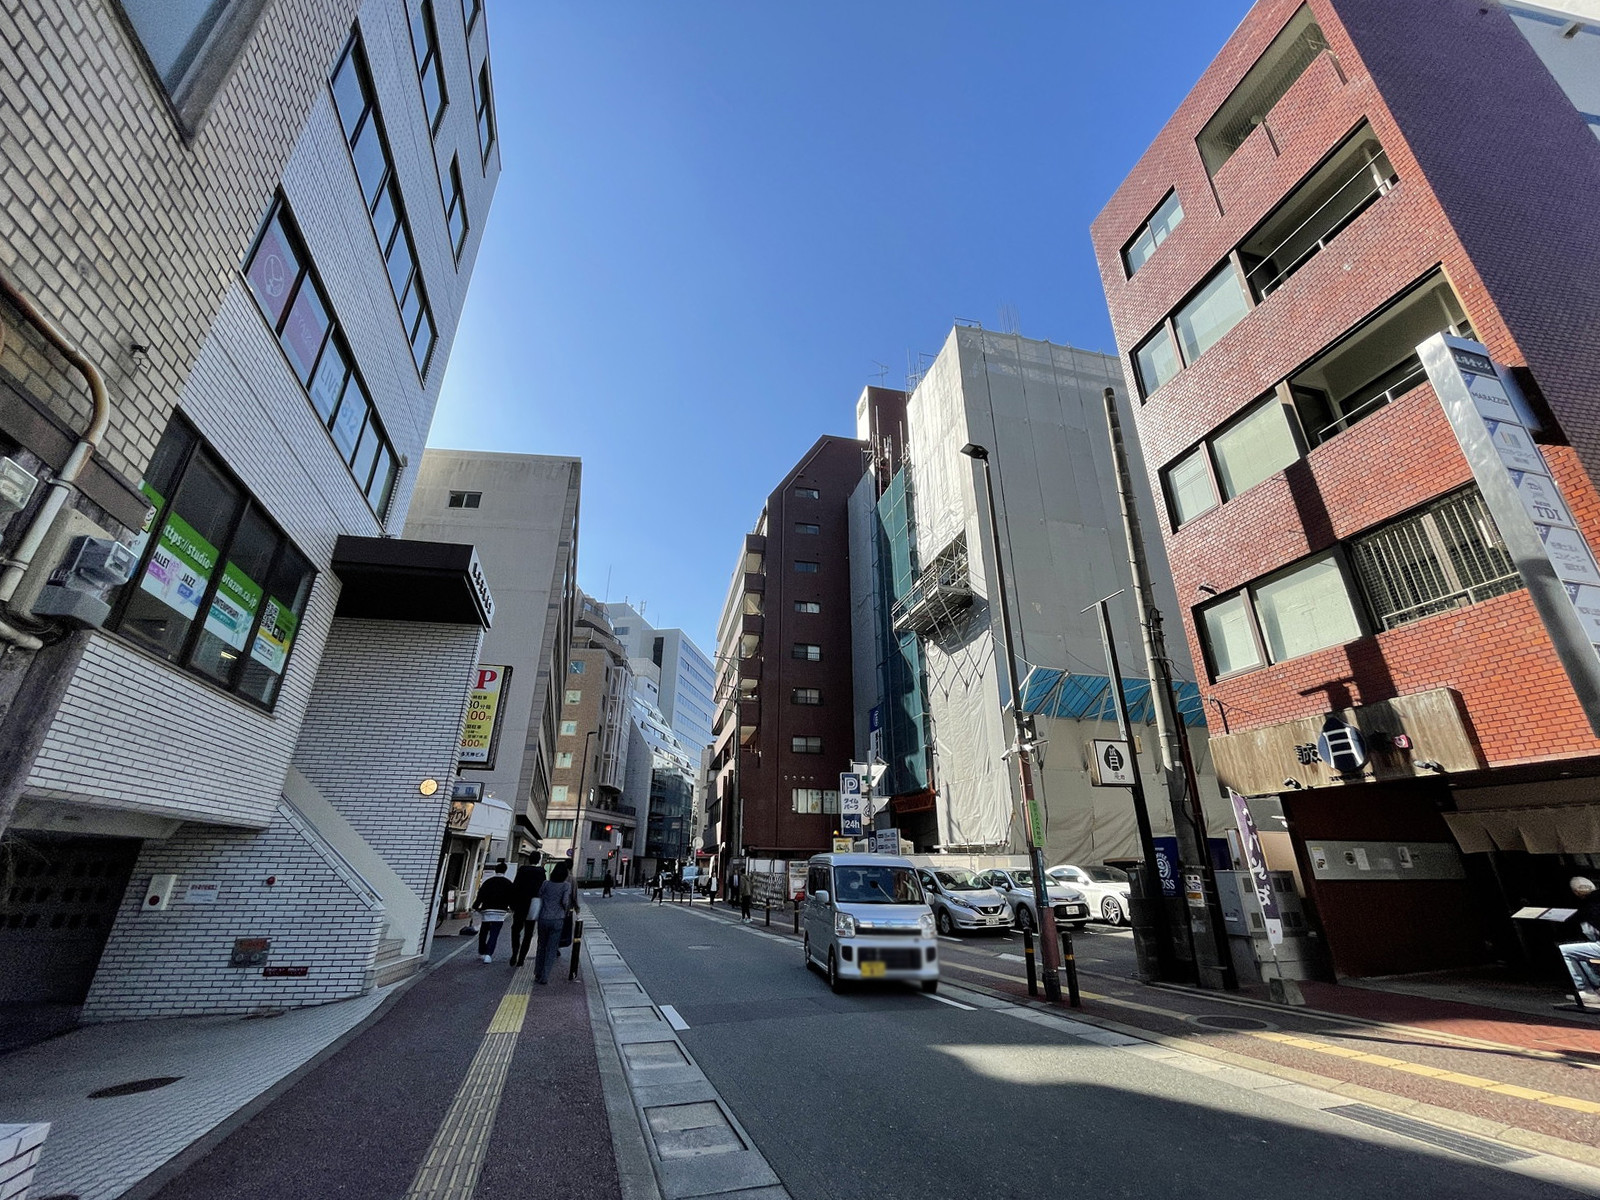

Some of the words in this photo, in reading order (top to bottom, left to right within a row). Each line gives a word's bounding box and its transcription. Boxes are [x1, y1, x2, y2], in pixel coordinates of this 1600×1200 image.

[321, 361, 340, 401] LIVE
[1532, 505, 1563, 521] TDI
[182, 573, 196, 588] JAZZ
[474, 669, 498, 690] P
[467, 710, 492, 721] 00円
[844, 777, 859, 794] P
[845, 820, 860, 829] 24h
